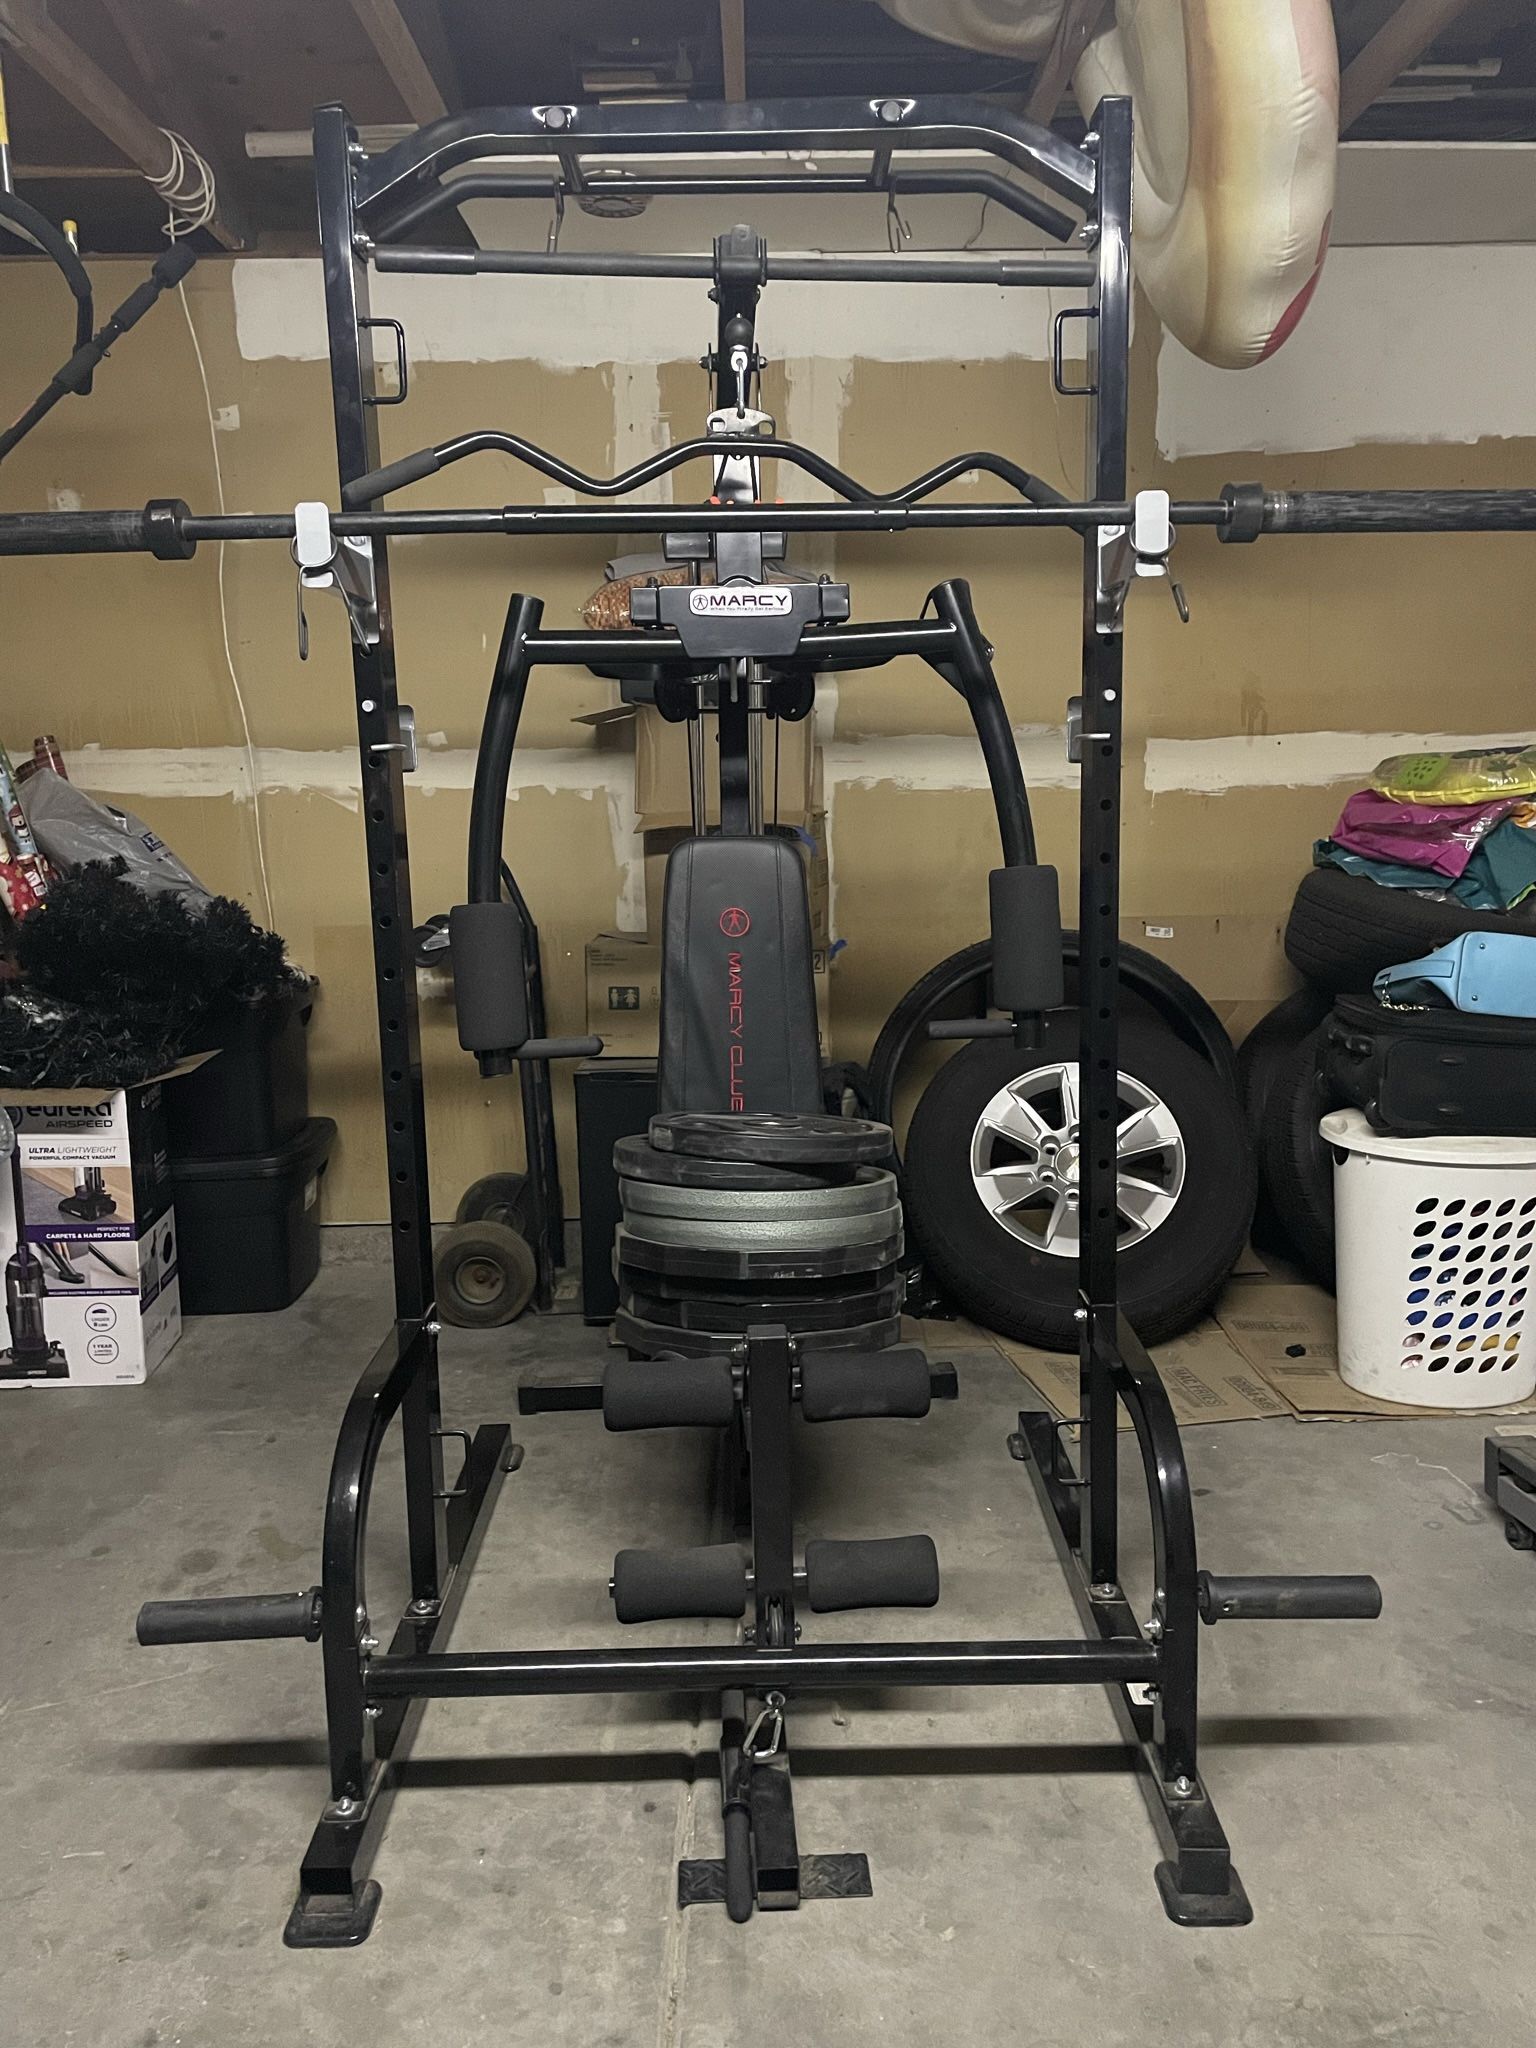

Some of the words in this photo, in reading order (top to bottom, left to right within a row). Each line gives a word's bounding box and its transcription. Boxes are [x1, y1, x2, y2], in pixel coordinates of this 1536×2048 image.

[710, 595, 788, 606] MARCY
[728, 952, 743, 1038] MARCY
[46, 1120, 113, 1128] AIRSPEED
[57, 1146, 117, 1154] LIGHTWEIGHT
